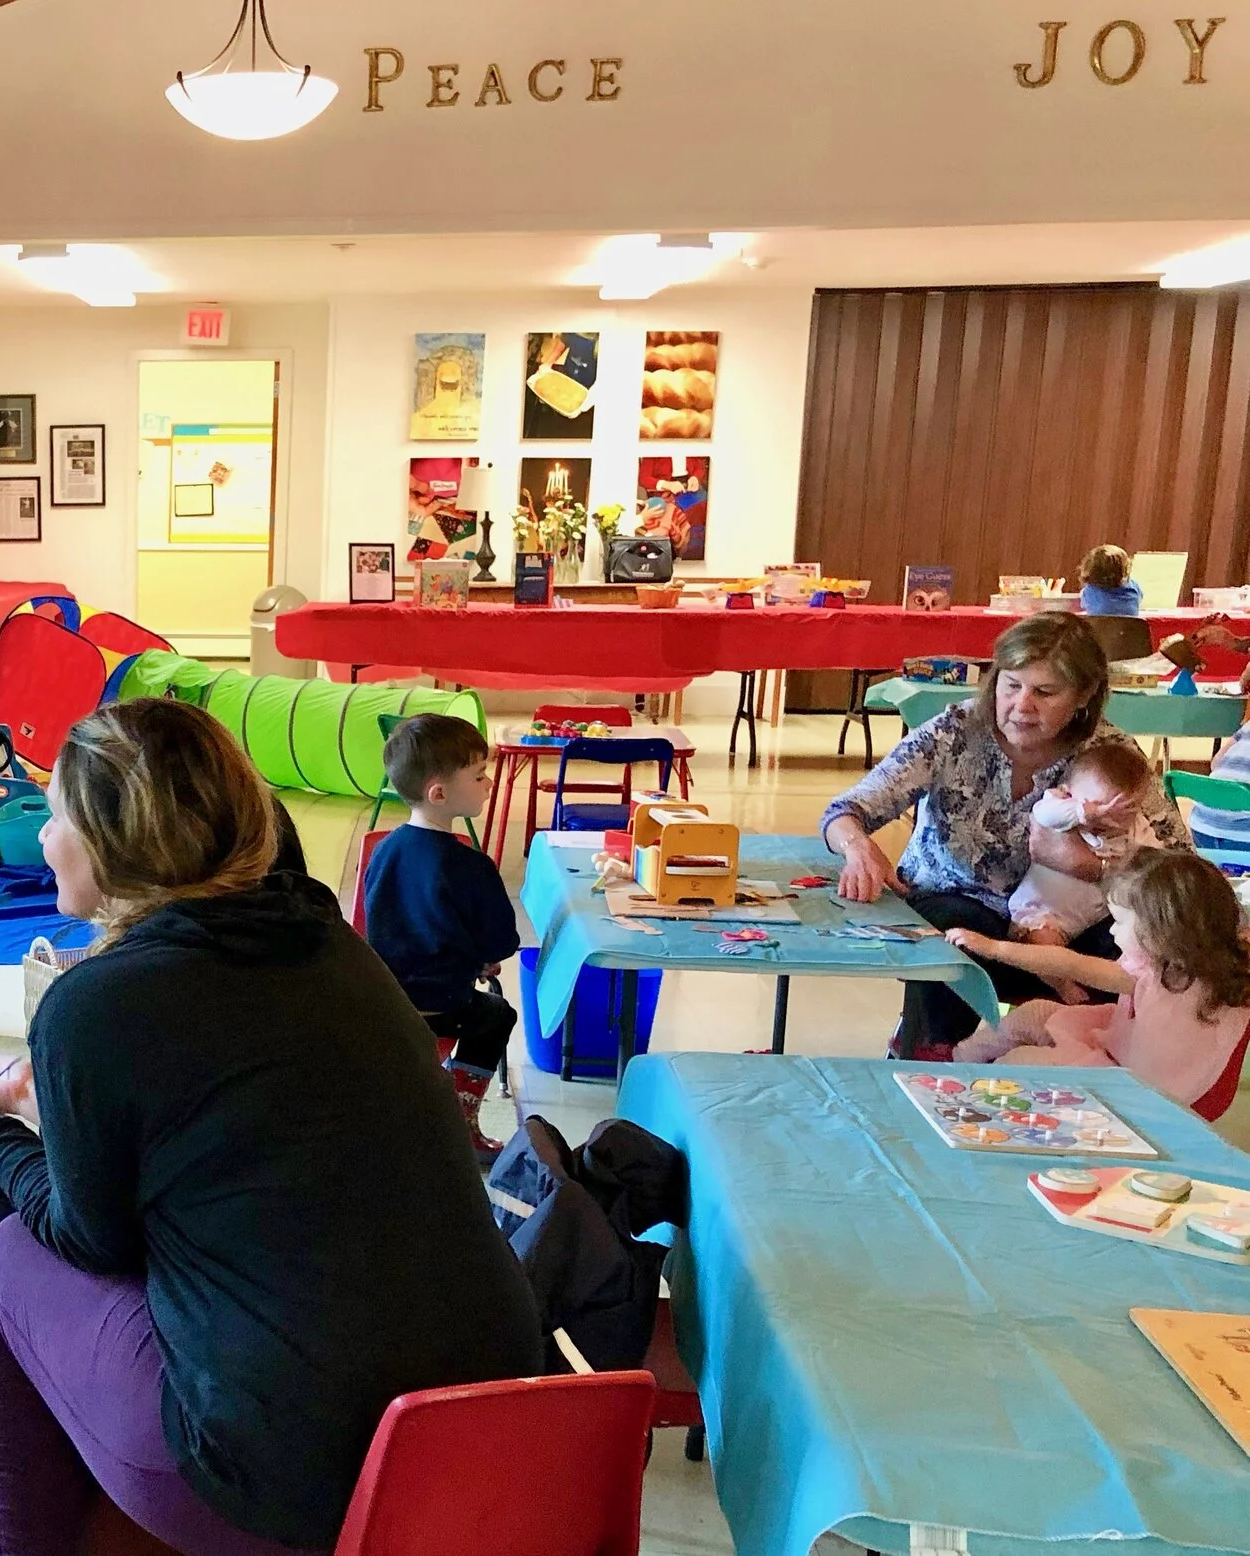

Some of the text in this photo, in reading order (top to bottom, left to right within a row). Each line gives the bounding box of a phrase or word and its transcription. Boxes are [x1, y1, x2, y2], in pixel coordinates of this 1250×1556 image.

[362, 47, 623, 112] PEACE
[1013, 17, 1226, 88] JOY
[188, 311, 223, 339] EXIT
